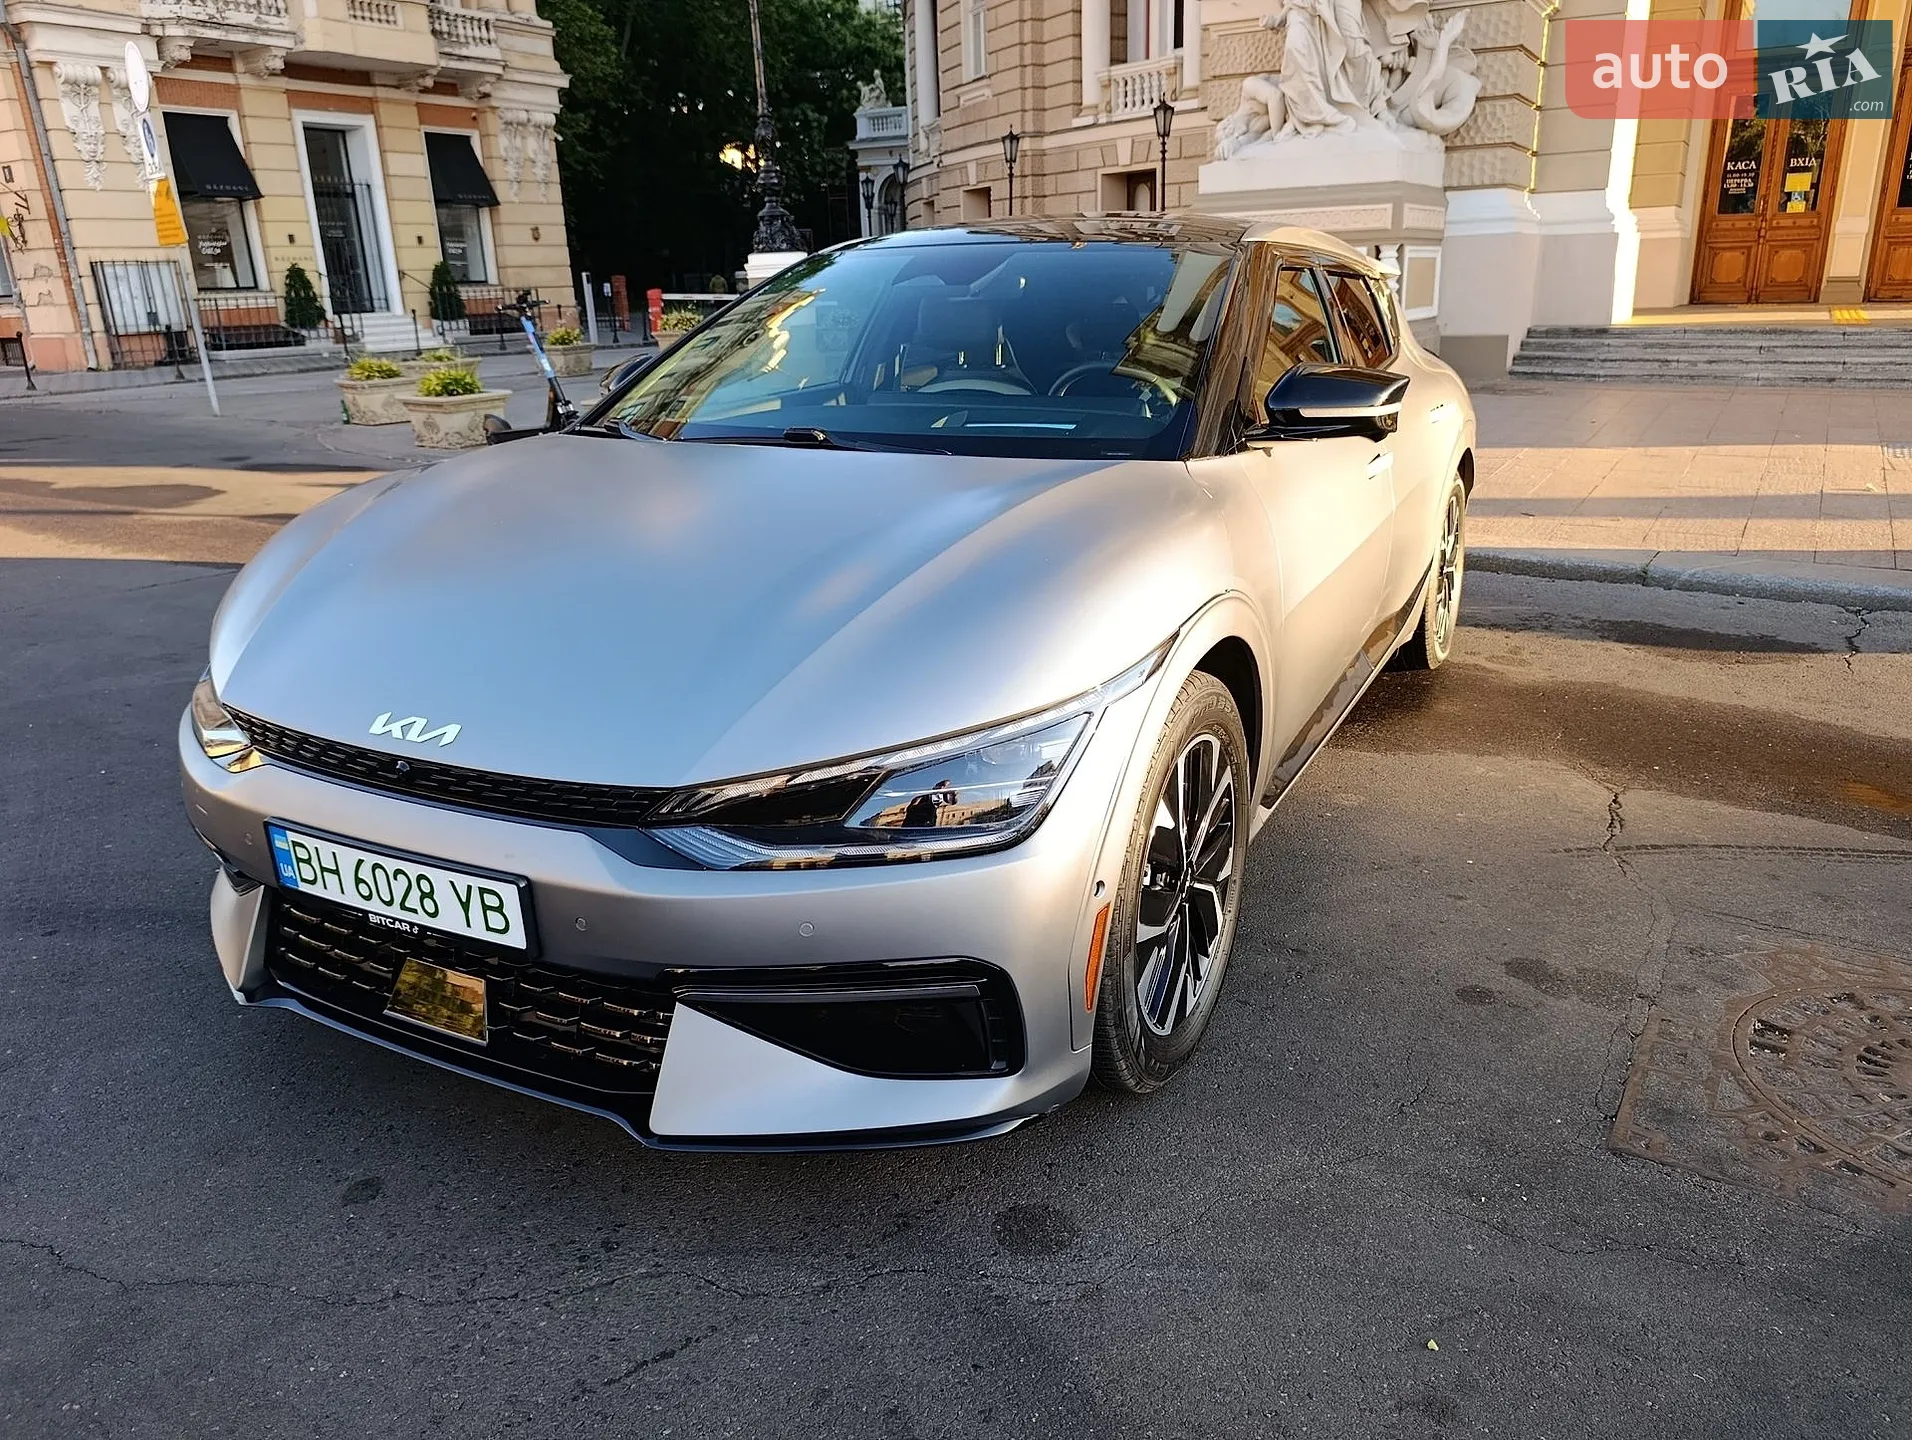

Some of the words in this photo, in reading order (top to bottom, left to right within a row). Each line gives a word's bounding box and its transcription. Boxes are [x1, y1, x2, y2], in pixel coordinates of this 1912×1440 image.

[1726, 161, 1757, 171] КАСА
[368, 711, 462, 748] KIA
[279, 862, 296, 880] UA
[291, 839, 345, 895] BH
[354, 858, 440, 919] 6028
[449, 880, 511, 935] YB
[368, 912, 411, 932] BITCAR
